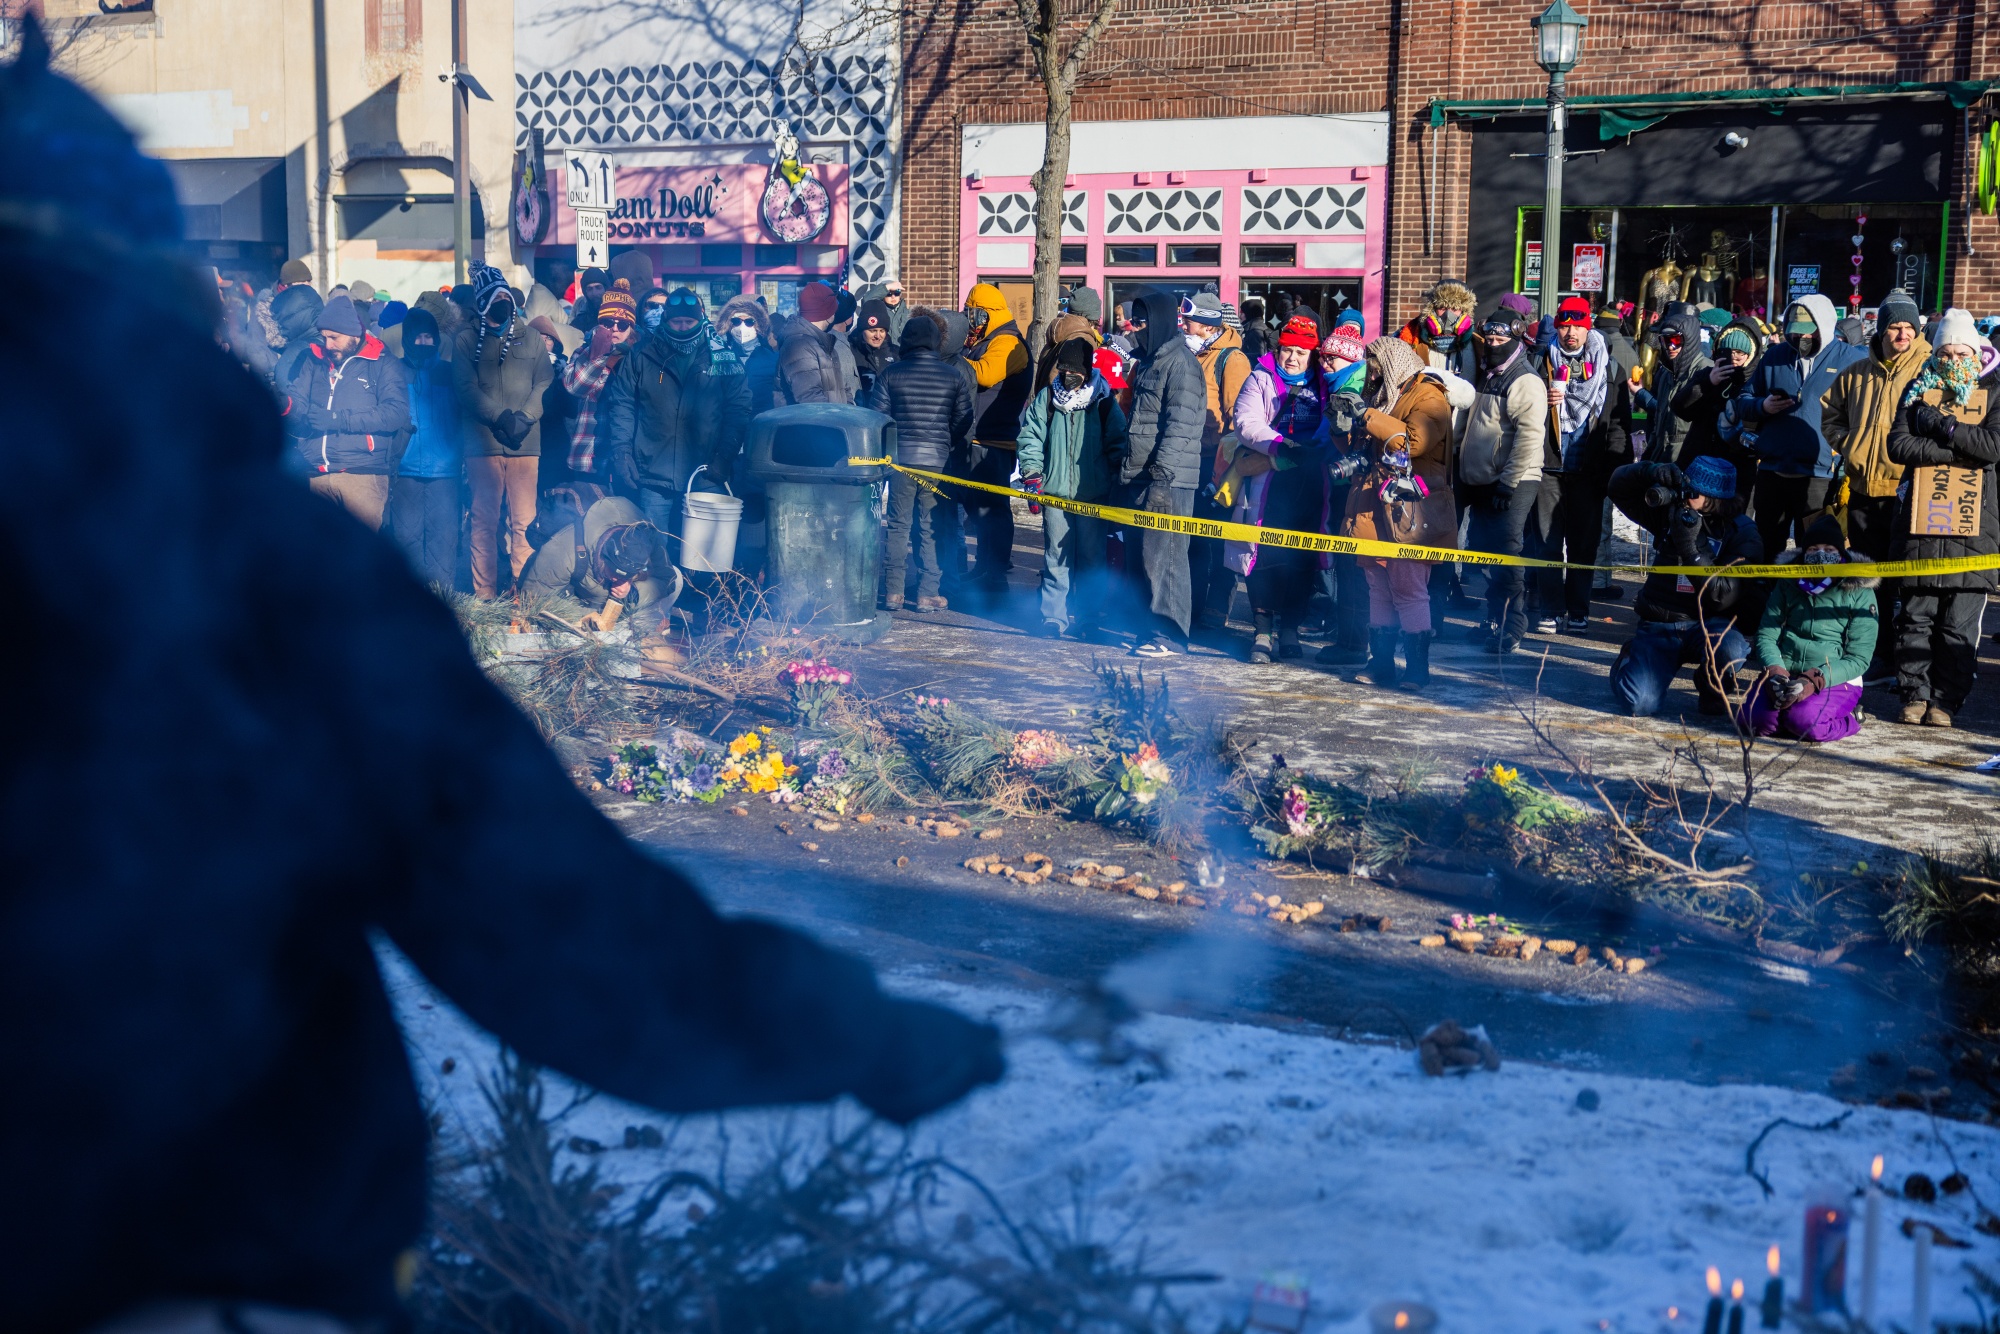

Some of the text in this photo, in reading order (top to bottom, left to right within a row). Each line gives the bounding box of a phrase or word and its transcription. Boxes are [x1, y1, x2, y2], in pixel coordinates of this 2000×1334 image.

[570, 191, 589, 203] ONLY
[608, 185, 717, 220] am Doll
[580, 216, 604, 227] TRUCK
[608, 222, 706, 238] DONUTS
[580, 230, 605, 242] ROUTE
[1904, 254, 1919, 302] OPE
[1963, 405, 1982, 415] I
[1079, 504, 1100, 517] POLICE
[1927, 500, 1953, 534] ICE
[1958, 490, 1978, 535] RIGHTS
[1134, 514, 1222, 537] POLICE LINE DO NOT CROSS
[1260, 531, 1358, 552] POLICE LINE DO NOT CROSS
[1397, 548, 1503, 566] POLICE LINE DO NOT CROSS
